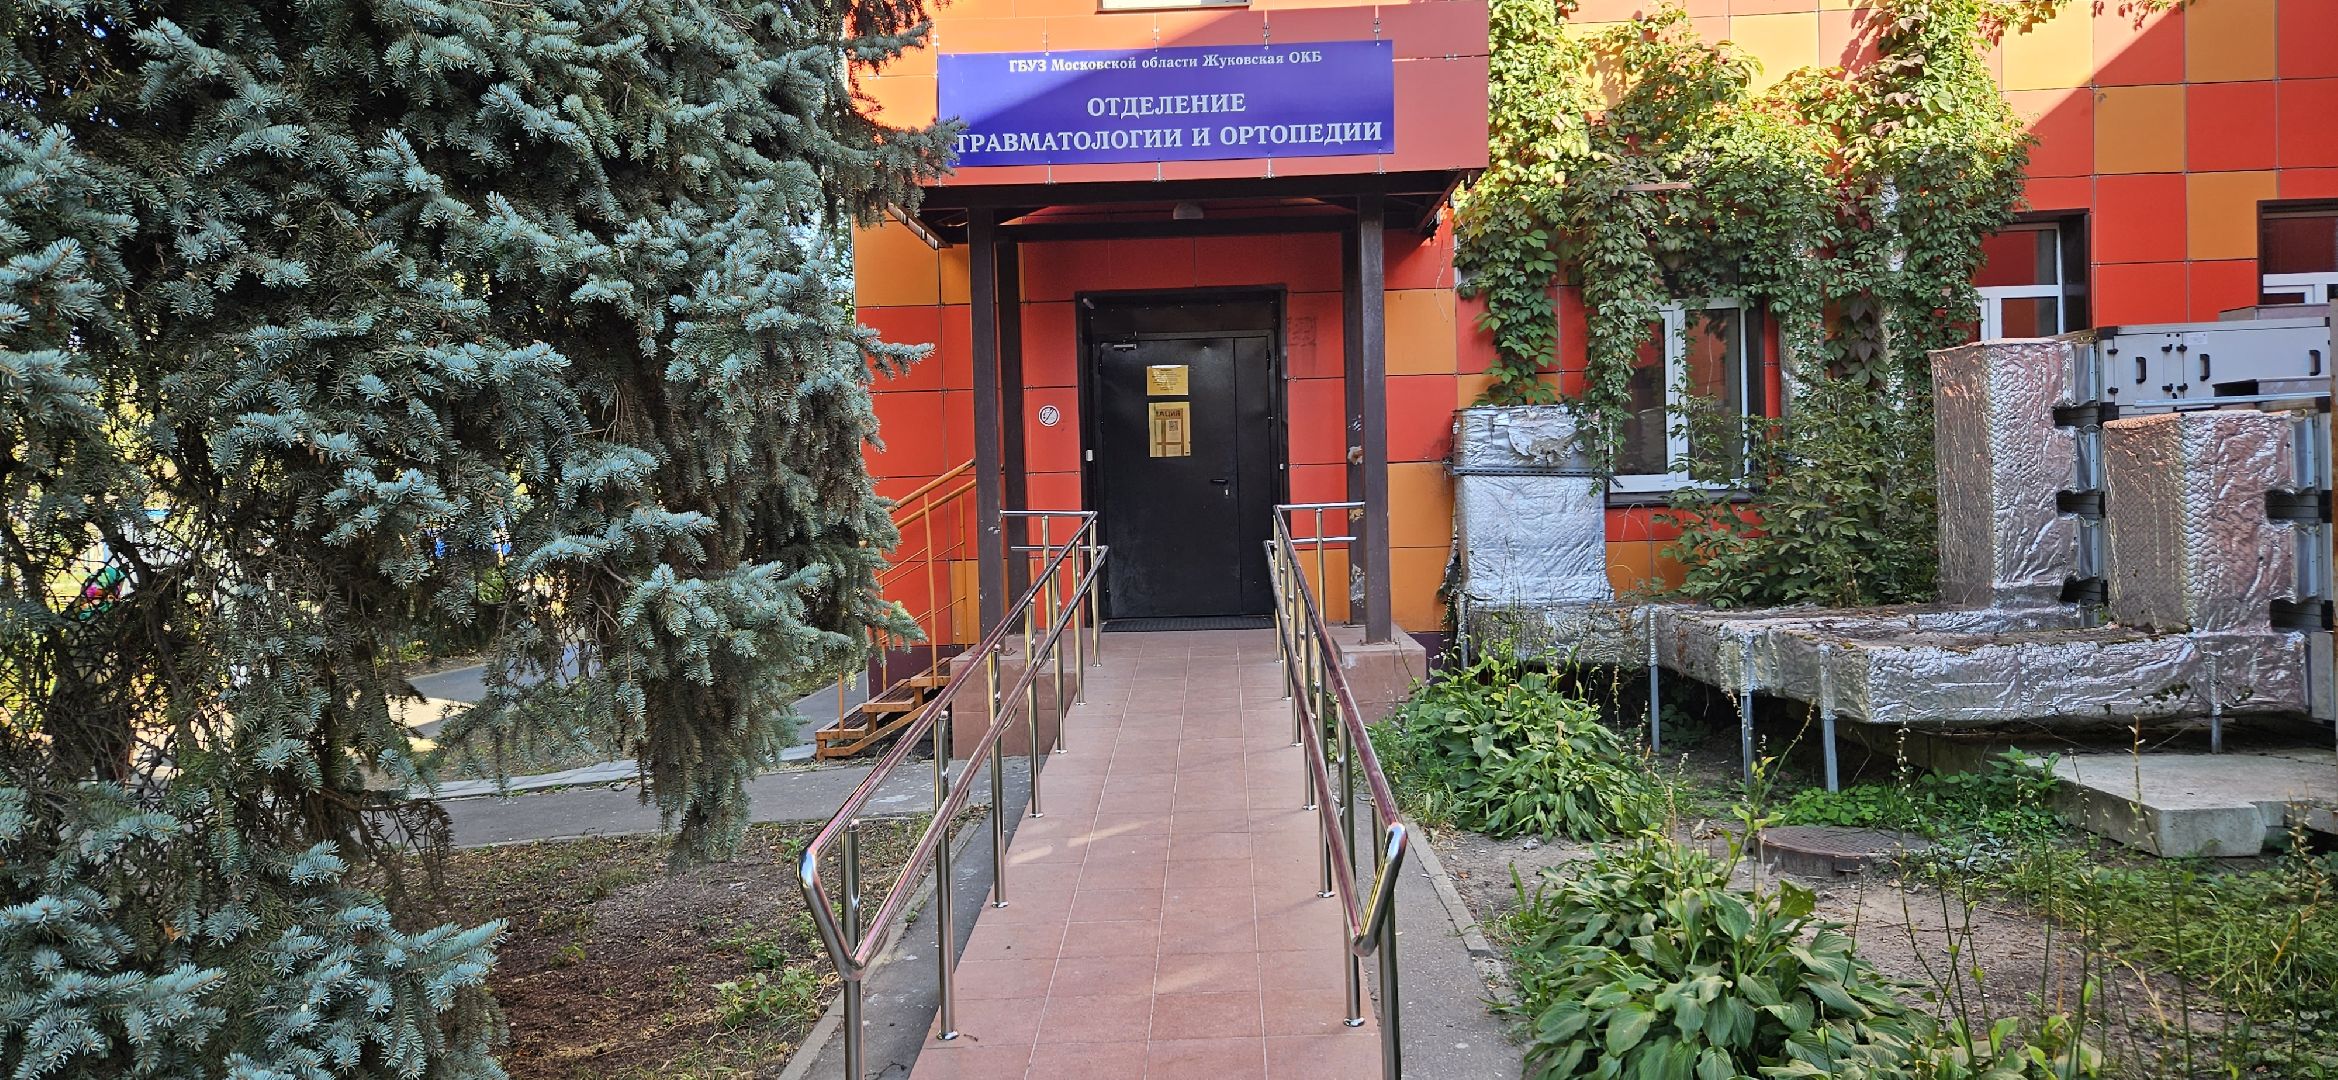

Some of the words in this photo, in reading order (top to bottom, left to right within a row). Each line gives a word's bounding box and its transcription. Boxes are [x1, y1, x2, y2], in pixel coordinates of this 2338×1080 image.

[1009, 59, 1047, 73] ГБУЗ
[1051, 57, 1136, 72] Московской
[1141, 56, 1198, 70] области
[1202, 53, 1284, 69] Жуковская
[1289, 51, 1323, 64] ОКБ
[1087, 93, 1246, 119] ОТДЕЛЕНИЕ
[957, 128, 1182, 153] ТРАВМАТОЛОГИИ
[1192, 128, 1211, 147] И
[1220, 122, 1382, 146] ОРТОПЕДИИ
